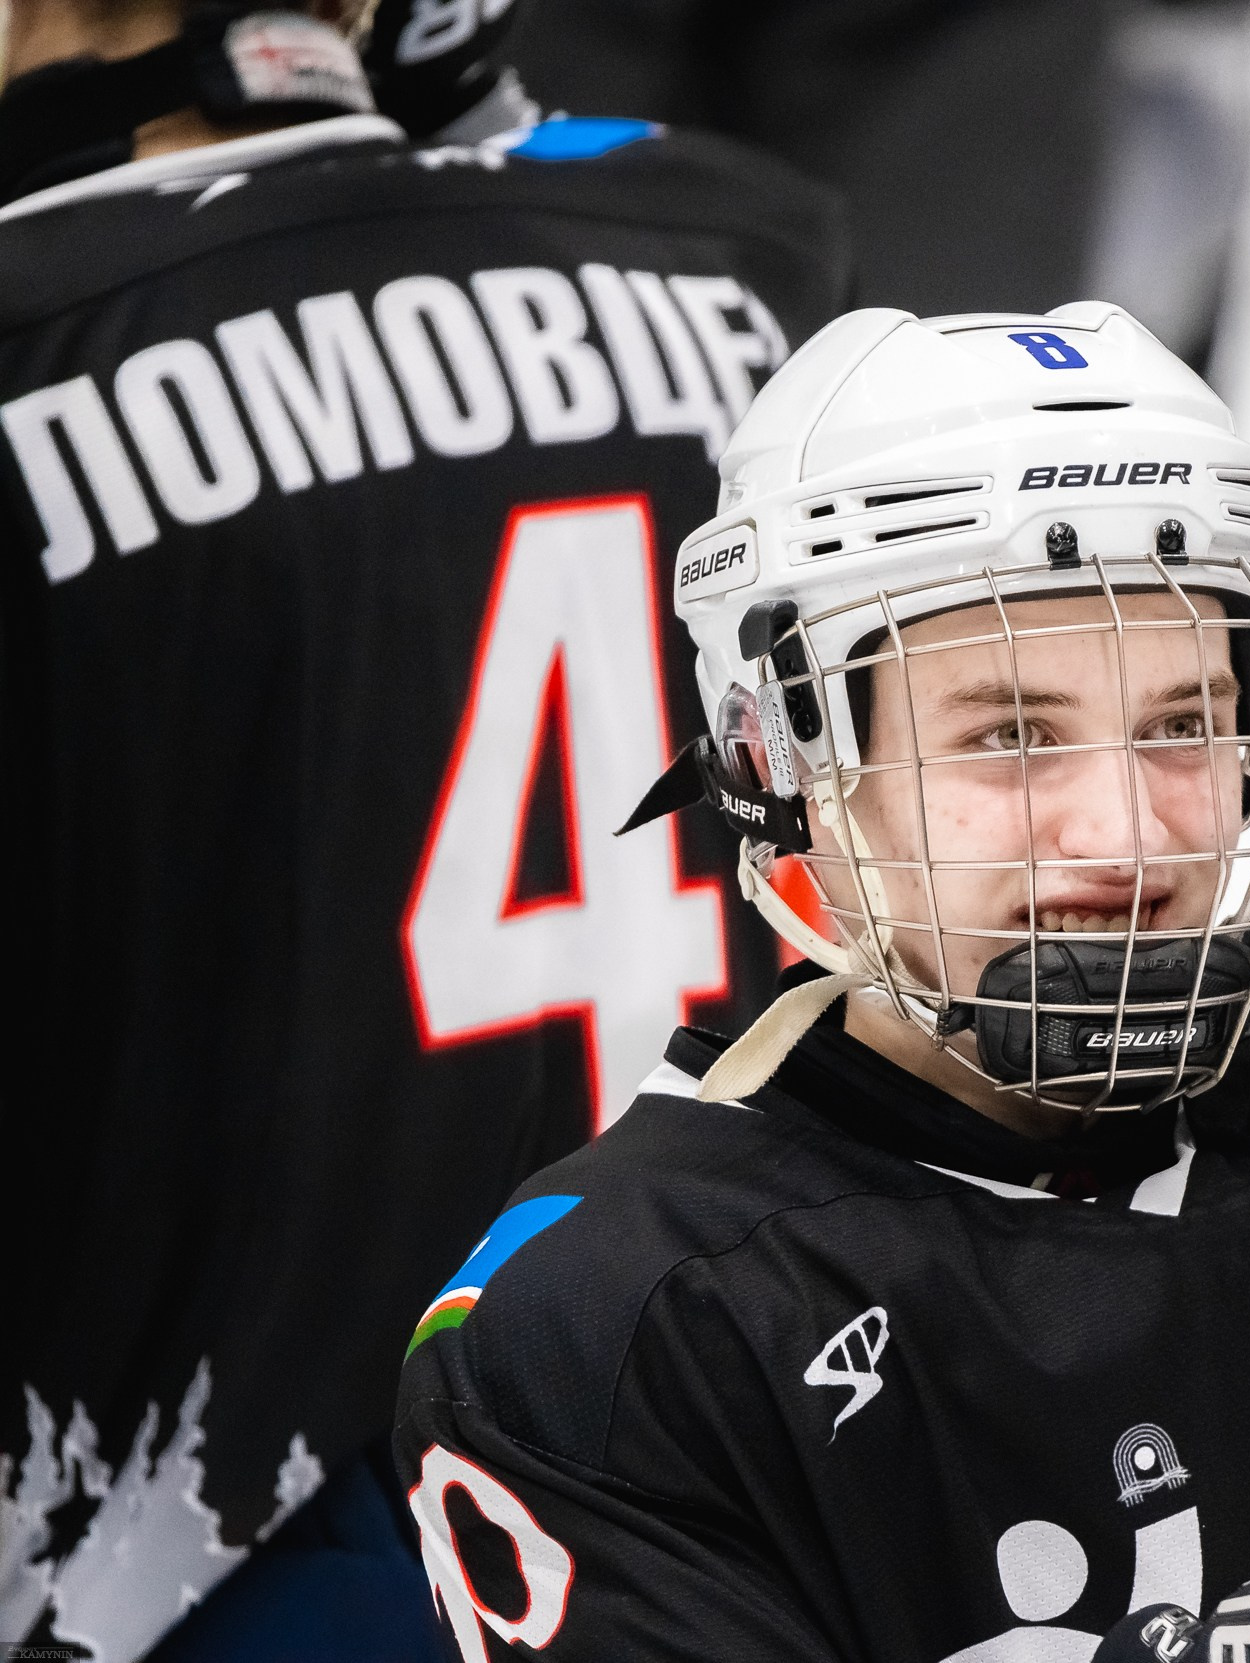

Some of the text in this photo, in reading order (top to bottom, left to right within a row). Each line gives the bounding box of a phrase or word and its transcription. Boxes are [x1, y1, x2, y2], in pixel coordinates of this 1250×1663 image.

[1007, 332, 1089, 370] 8
[1018, 462, 1193, 491] BAUER
[680, 542, 747, 588] BAUER
[403, 495, 838, 1145] 4
[719, 788, 766, 824] AUER
[1086, 1026, 1198, 1048] BAUER
